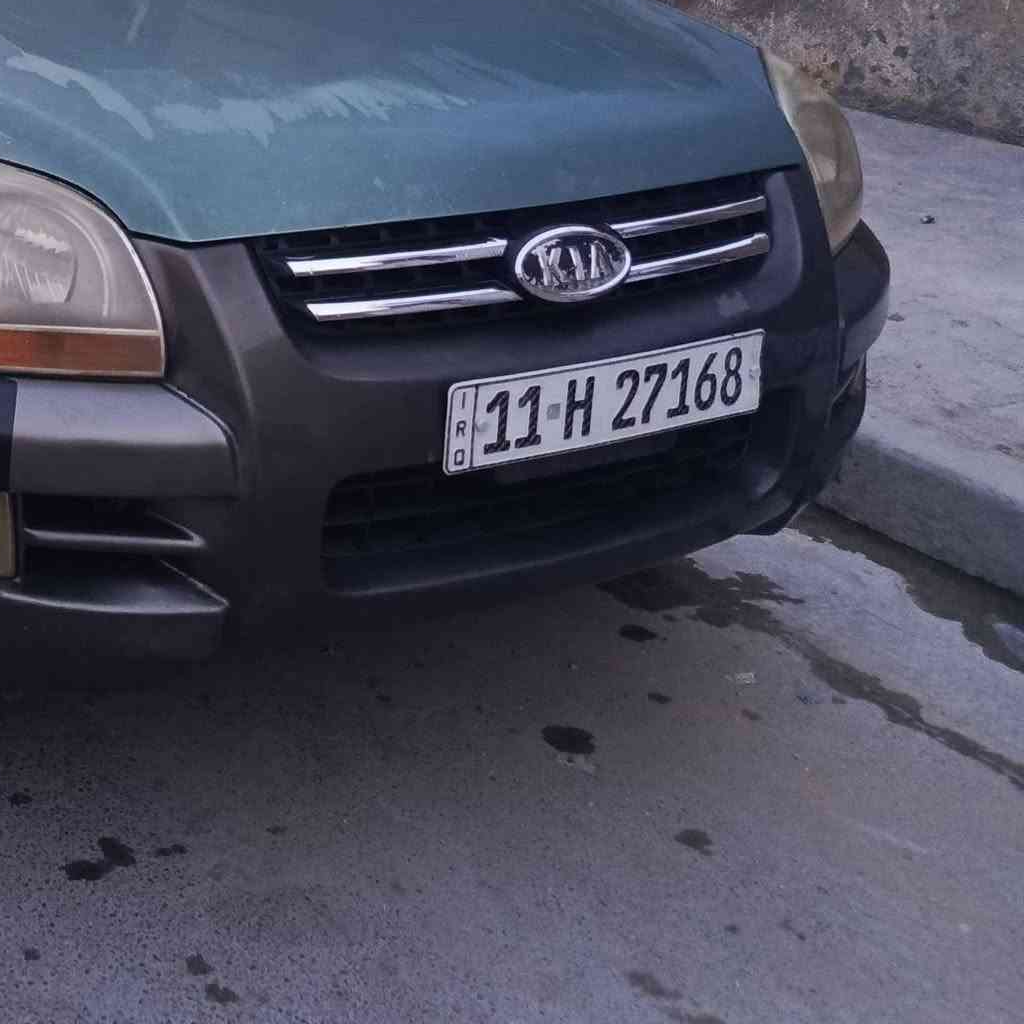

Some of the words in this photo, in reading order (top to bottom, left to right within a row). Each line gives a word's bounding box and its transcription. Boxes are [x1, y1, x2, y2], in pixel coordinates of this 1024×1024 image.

[531, 238, 617, 287] KIA
[483, 385, 542, 455] 11
[563, 376, 596, 441] H
[611, 347, 743, 432] 27168
